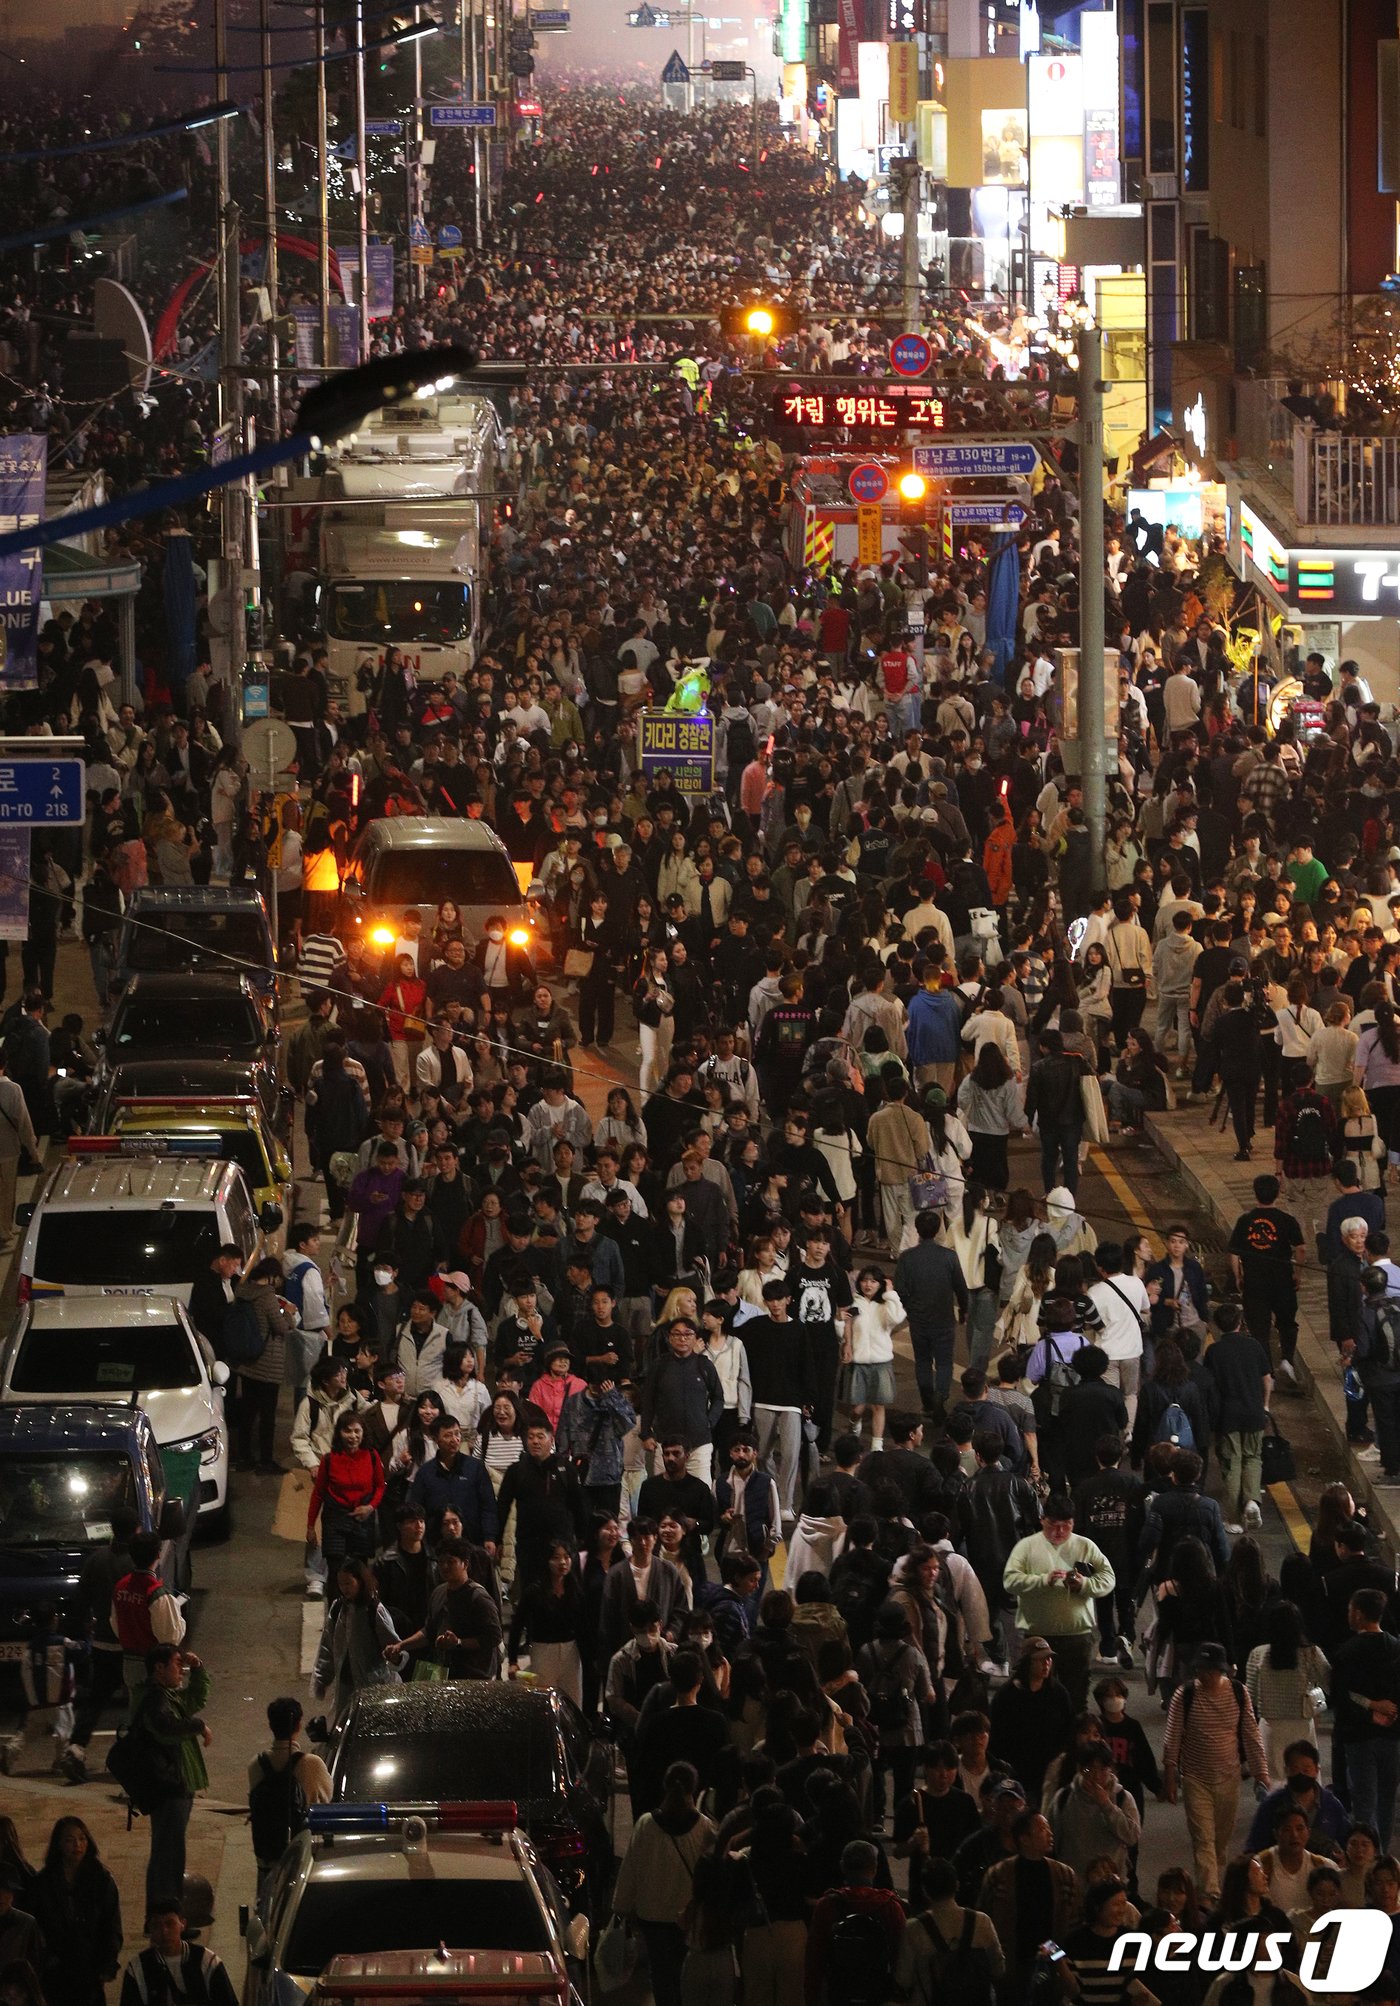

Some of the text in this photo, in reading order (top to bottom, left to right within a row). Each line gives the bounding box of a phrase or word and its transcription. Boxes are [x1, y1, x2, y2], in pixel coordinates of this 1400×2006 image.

[836, 397, 898, 425] 행위는
[1354, 561, 1400, 601] 7-
[883, 660, 902, 669] STAFF
[645, 722, 710, 750] 키다리 경찰관
[52, 767, 60, 780] 2
[674, 766, 702, 777] 시민의
[45, 803, 69, 817] 218
